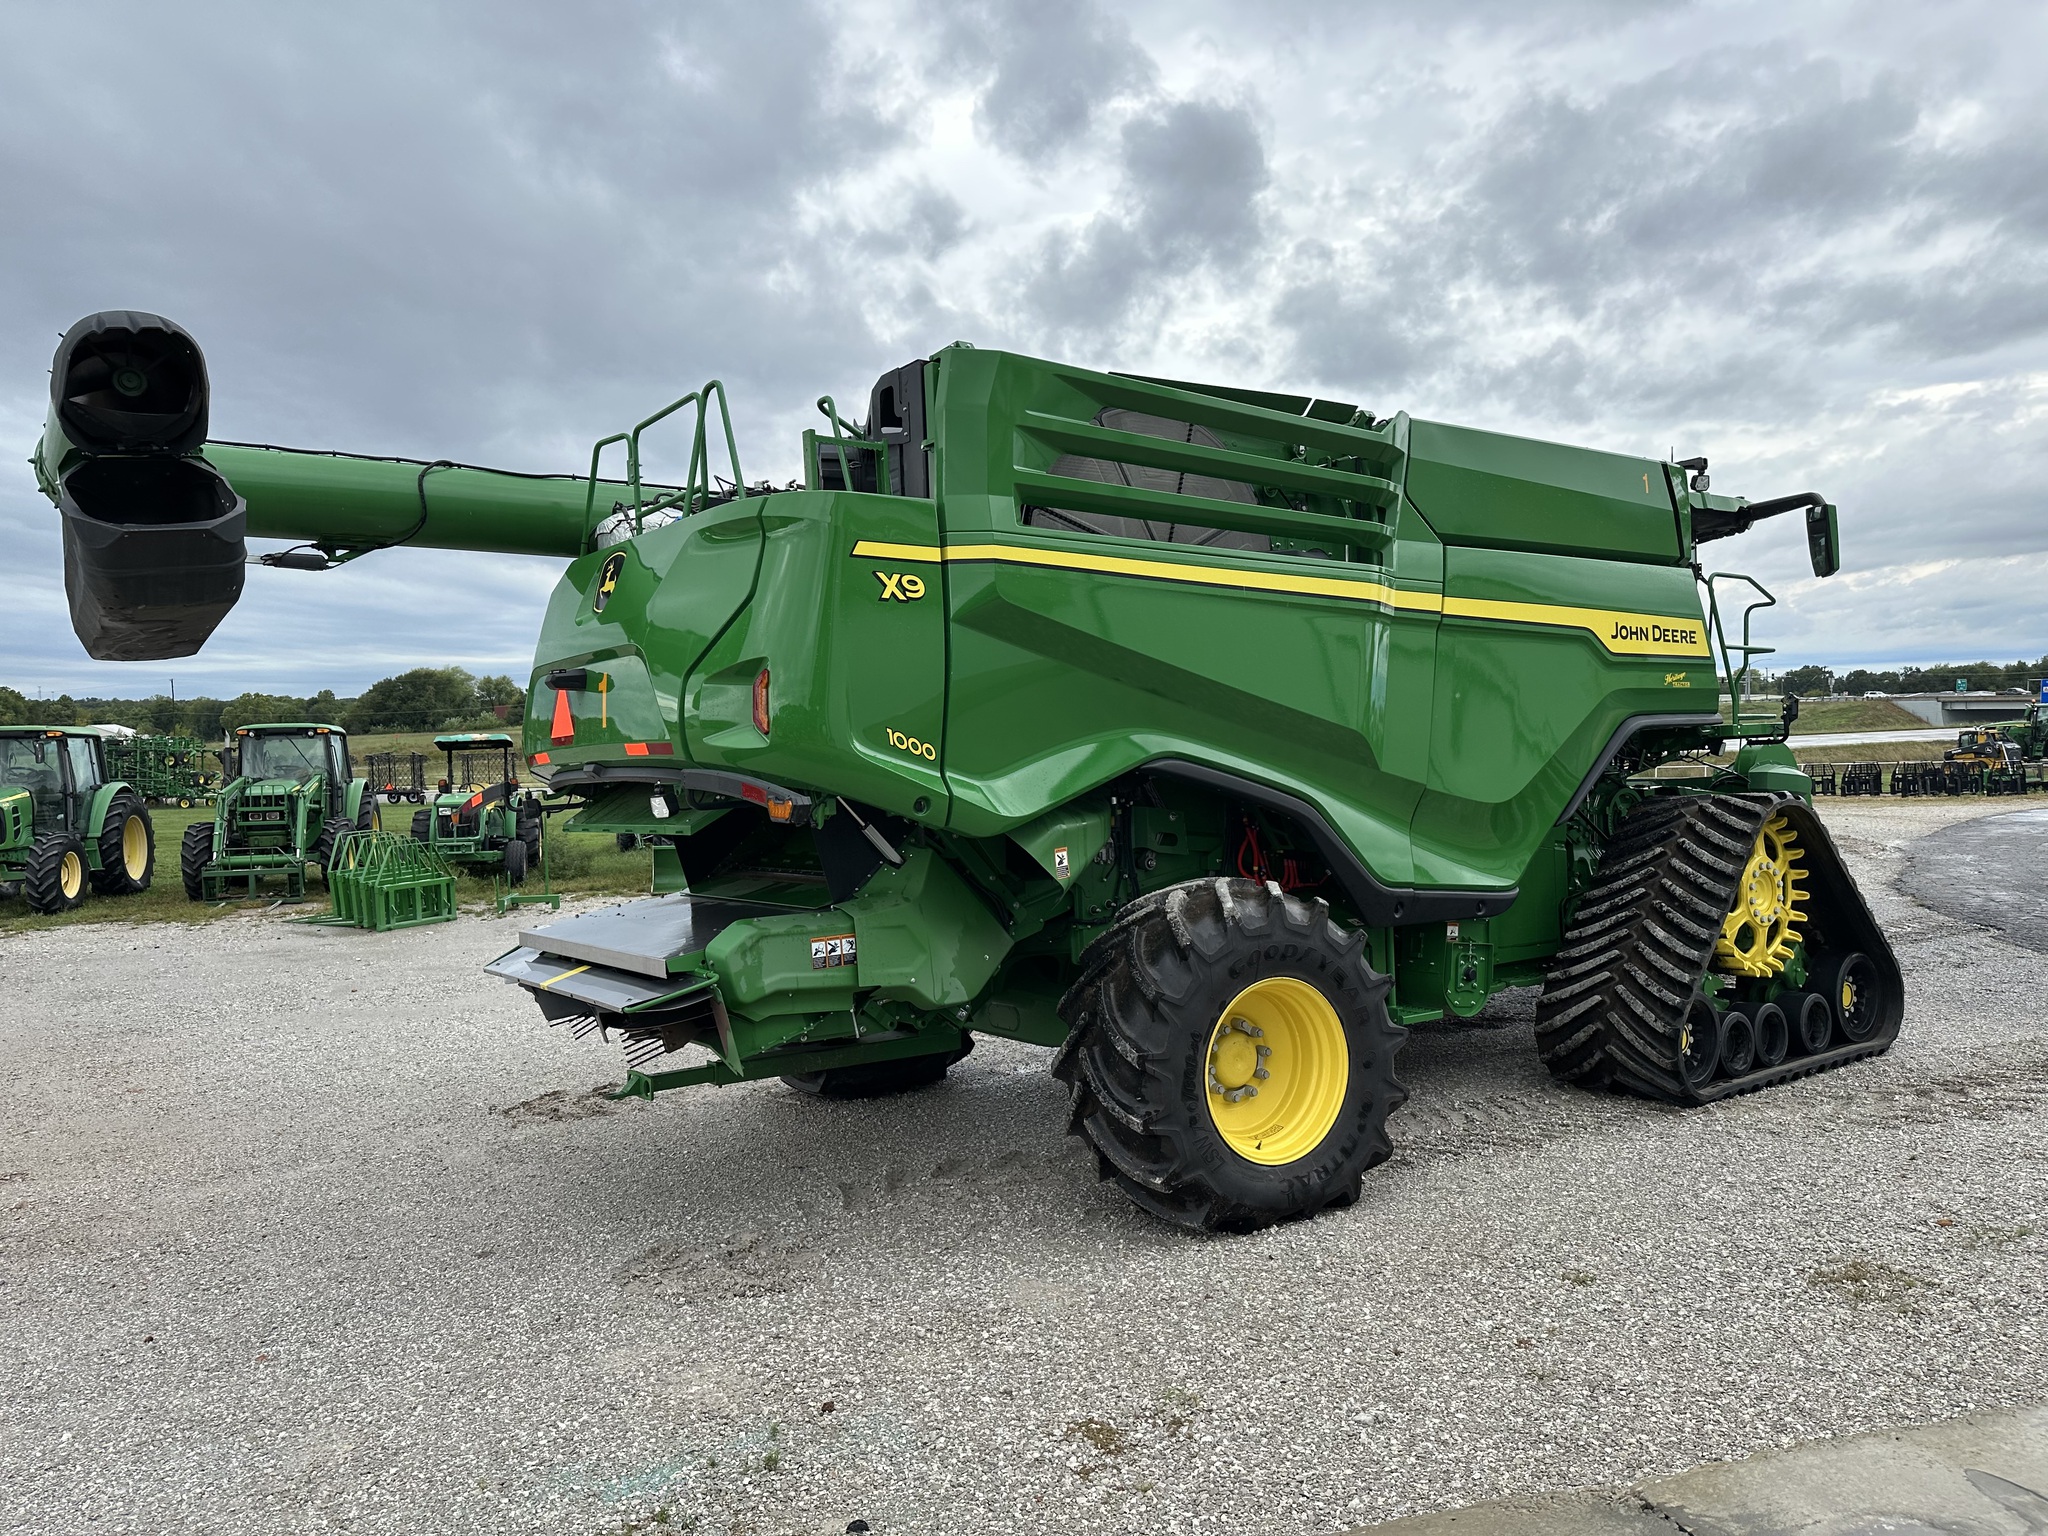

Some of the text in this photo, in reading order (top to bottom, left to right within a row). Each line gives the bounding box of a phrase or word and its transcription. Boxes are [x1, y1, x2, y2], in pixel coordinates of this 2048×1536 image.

[872, 570, 926, 603] X9
[1611, 621, 1697, 644] JOHN DEERE
[886, 726, 937, 761] 1000
